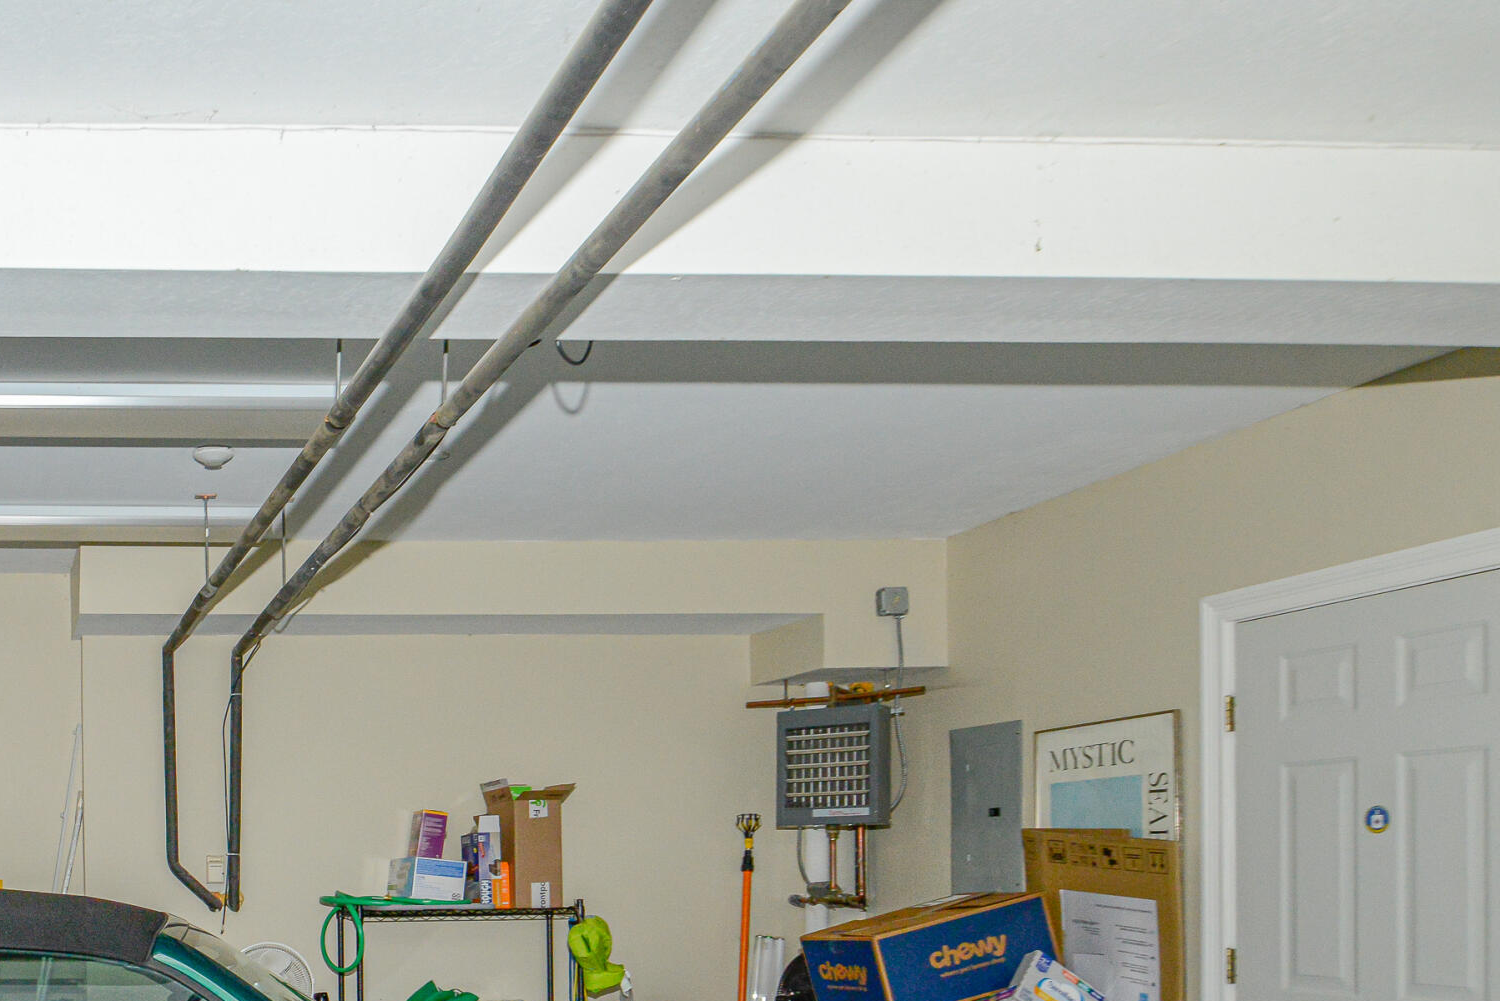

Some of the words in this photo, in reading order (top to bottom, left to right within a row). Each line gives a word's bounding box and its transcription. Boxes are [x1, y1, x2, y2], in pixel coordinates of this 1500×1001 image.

[1049, 739, 1135, 773] MYSTIC
[929, 934, 1007, 969] chewy
[818, 960, 868, 986] chewy
